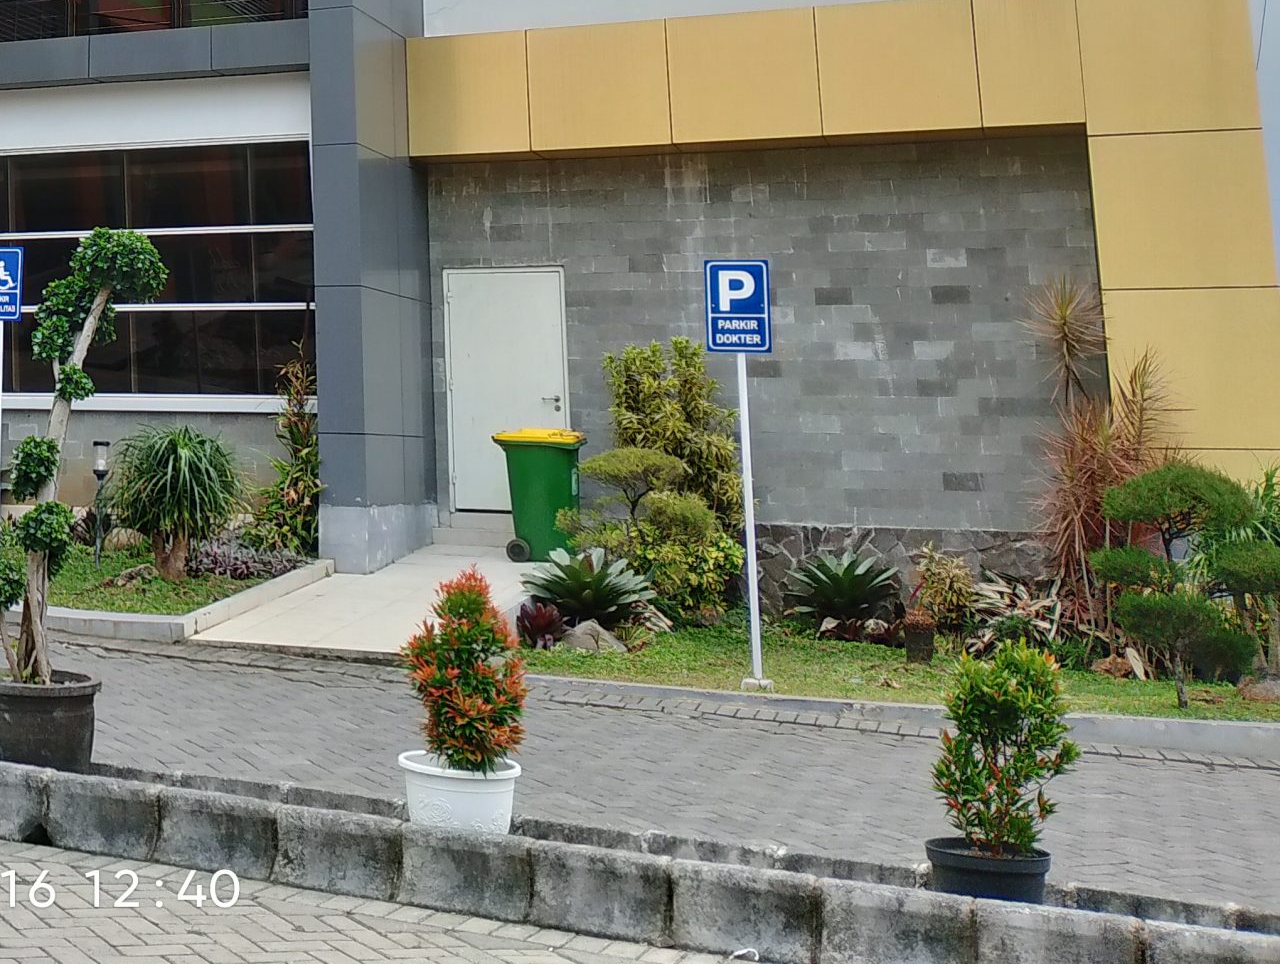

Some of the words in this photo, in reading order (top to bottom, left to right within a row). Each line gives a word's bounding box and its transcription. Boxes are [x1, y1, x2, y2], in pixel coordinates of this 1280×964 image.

[718, 270, 756, 312] P
[717, 319, 759, 330] PARKIR
[715, 333, 762, 345] DOKTER
